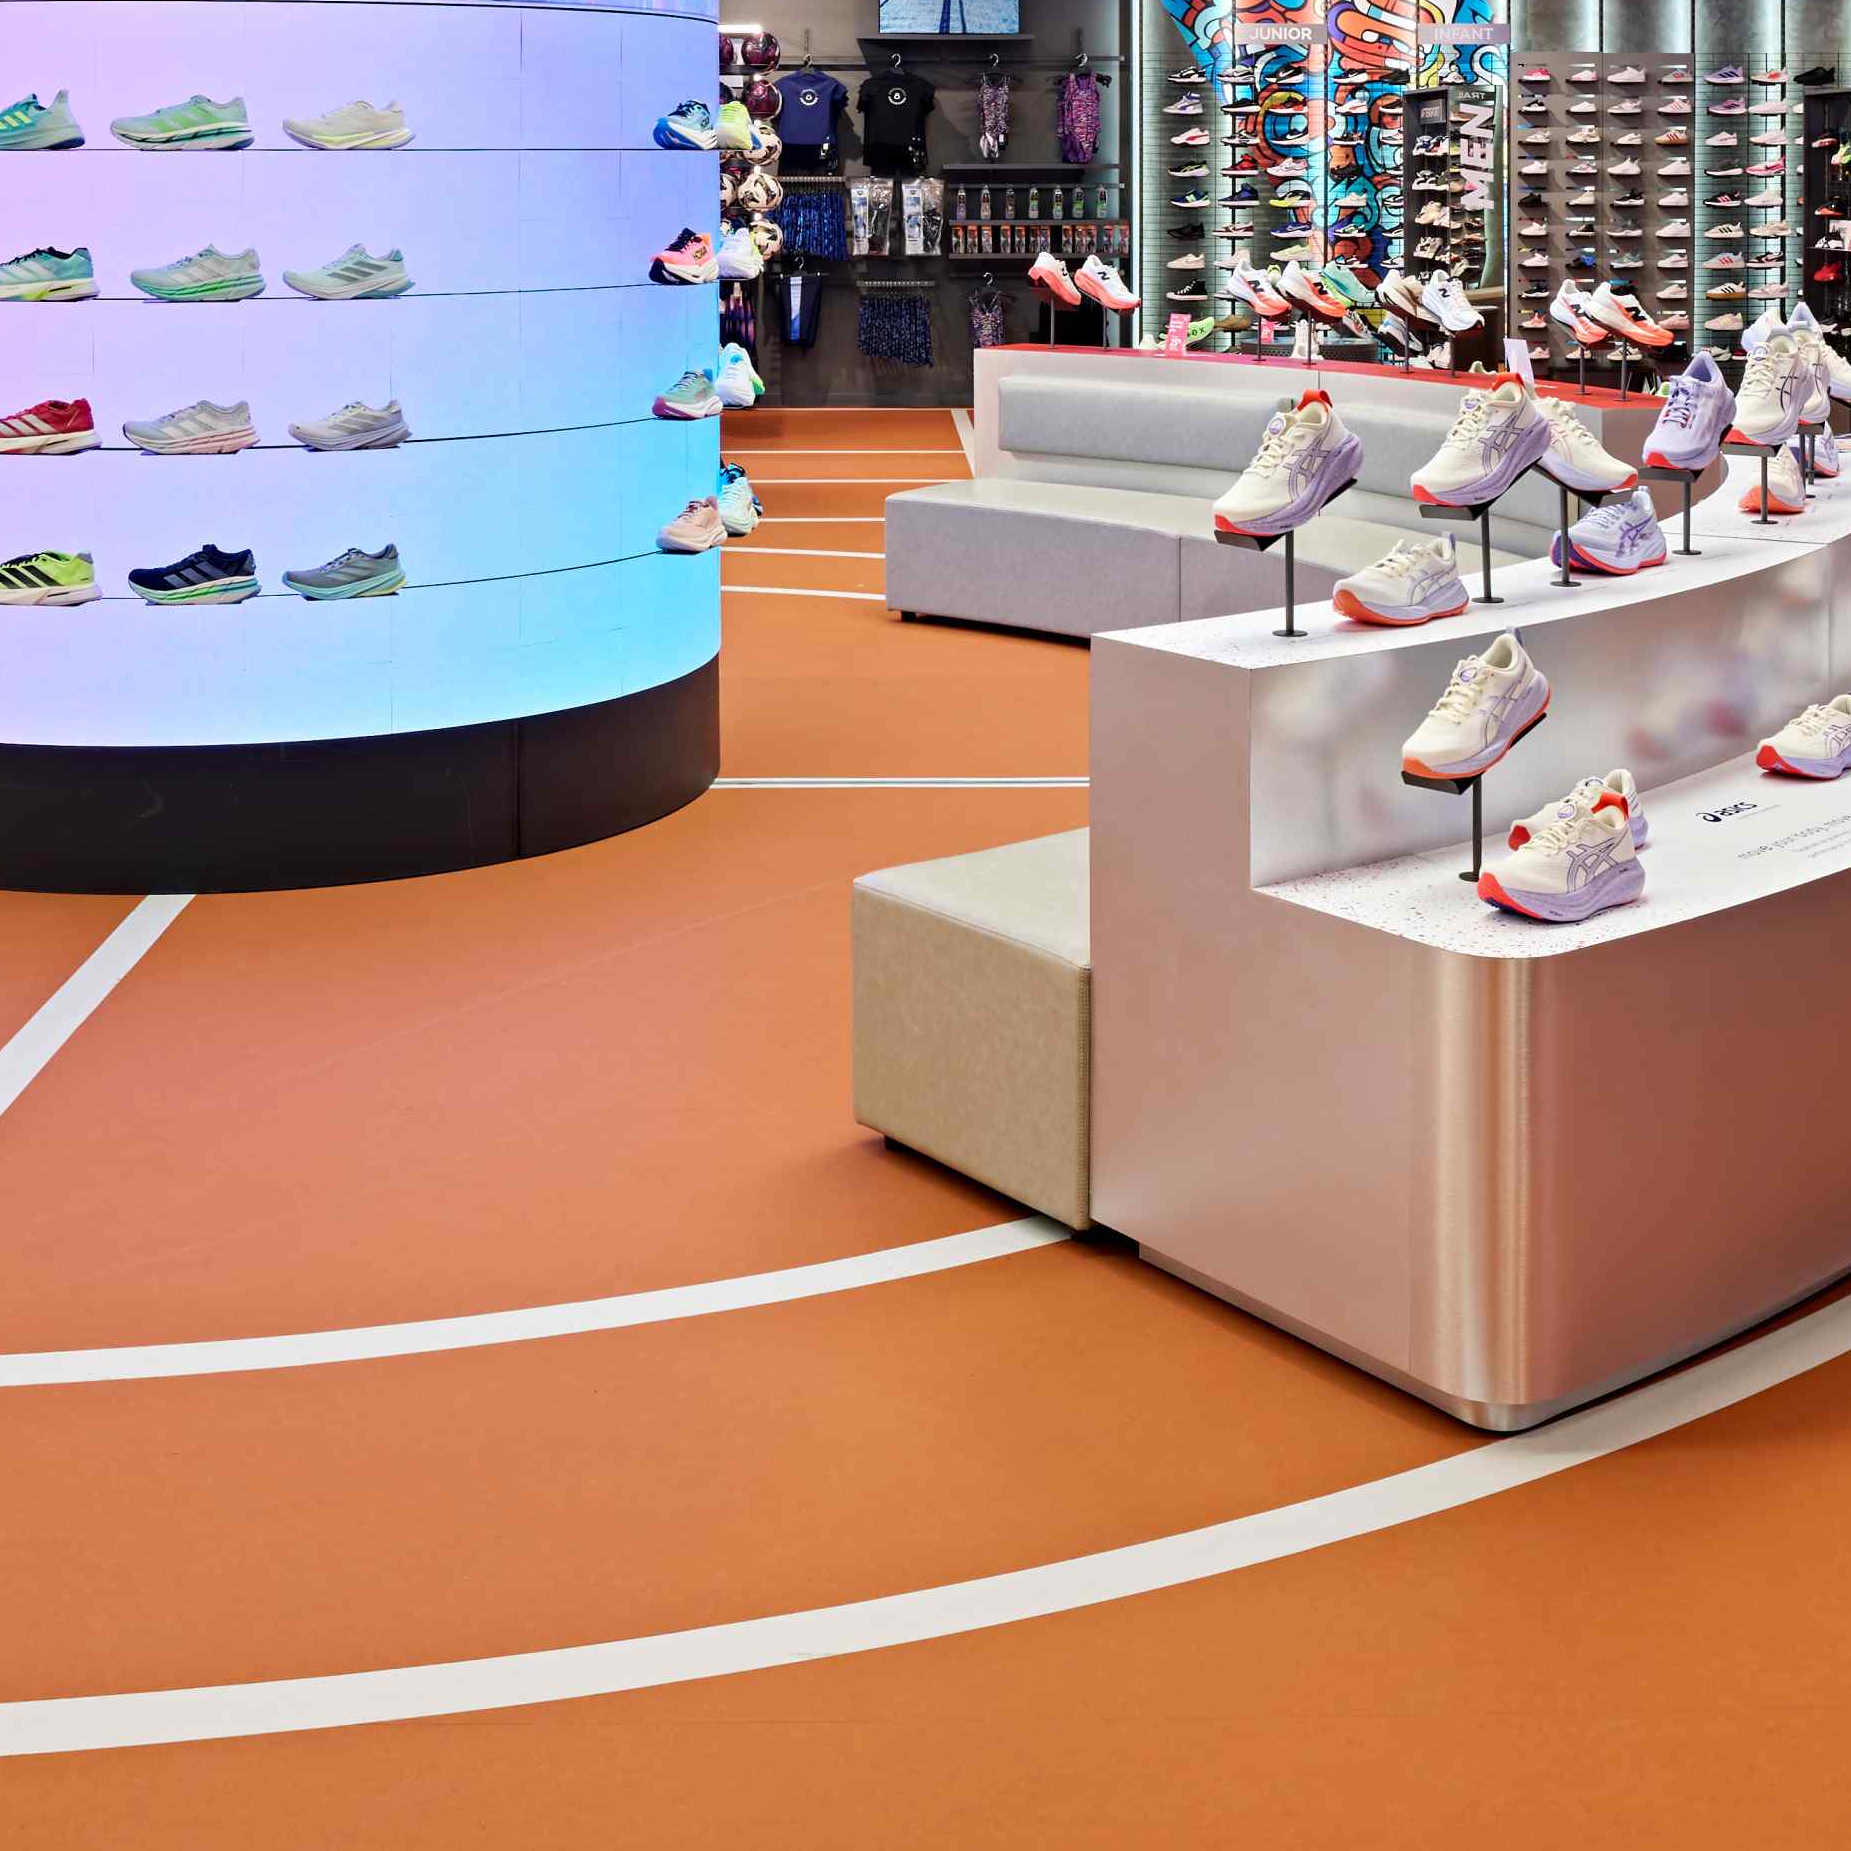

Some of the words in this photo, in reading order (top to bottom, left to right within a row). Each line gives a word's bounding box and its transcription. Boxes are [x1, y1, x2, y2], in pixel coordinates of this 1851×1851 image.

[1248, 26, 1313, 41] JUNIOR
[1433, 27, 1494, 41] INFANT
[1460, 102, 1495, 211] MEN
